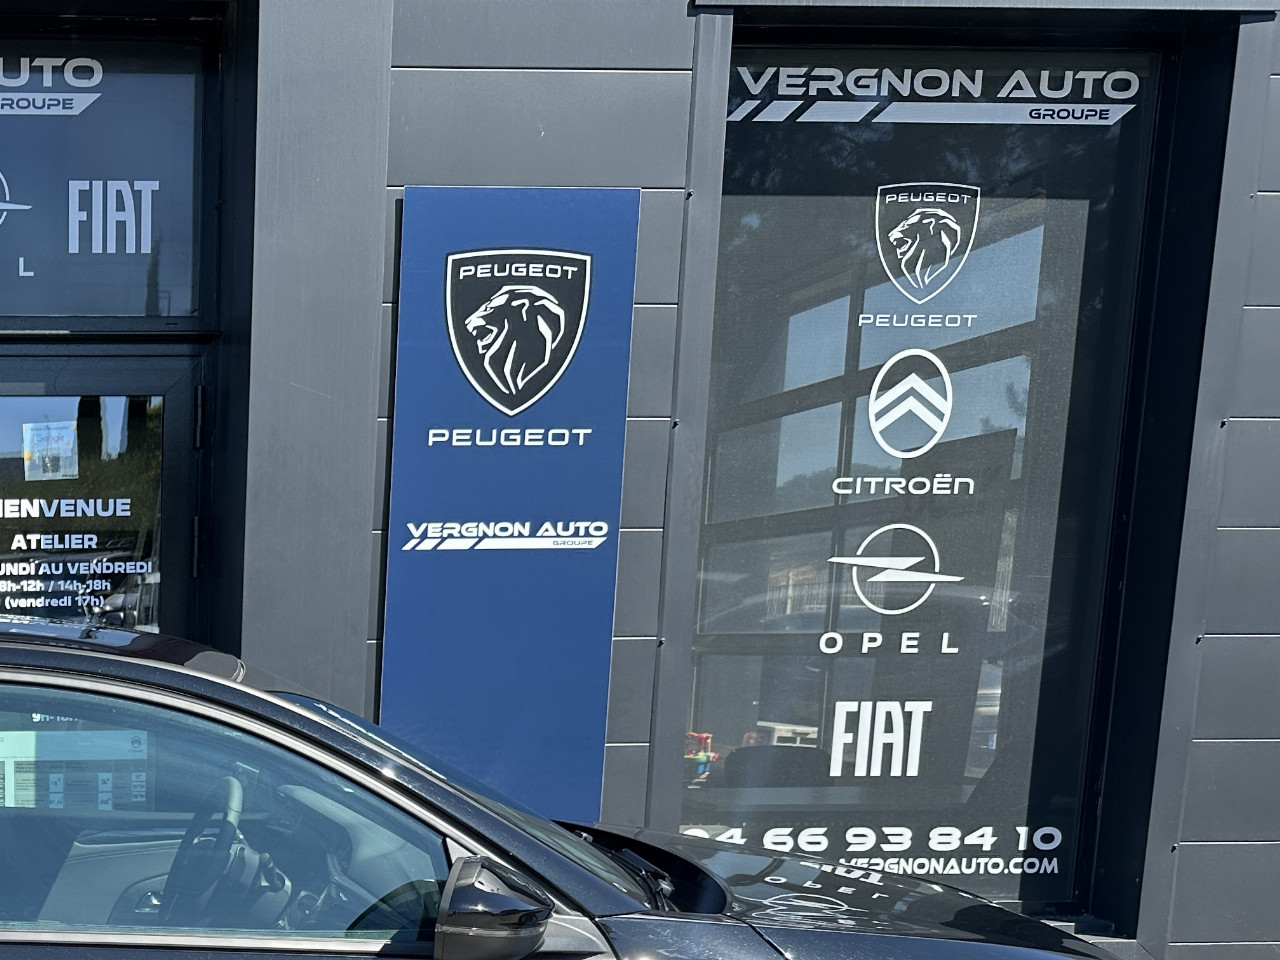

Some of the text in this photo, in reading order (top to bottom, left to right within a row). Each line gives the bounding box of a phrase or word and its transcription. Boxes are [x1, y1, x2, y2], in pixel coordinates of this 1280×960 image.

[736, 66, 1140, 99] VERGNON AUTO
[1028, 108, 1111, 120] GROUPE
[885, 192, 972, 205] PEUGEOT
[68, 180, 160, 254] FIAT
[458, 263, 578, 280] PEUGEOT
[858, 314, 978, 328] PEUGEOT
[427, 427, 593, 447] PEUGEOT
[406, 521, 609, 538] VERGNON AUTO
[10, 533, 98, 550] ATELIER
[552, 539, 594, 547] GROUPE
[38, 561, 64, 576] AU
[67, 561, 153, 575] VENDREDI
[48, 581, 54, 592] /
[57, 579, 111, 592] 14h-18h
[4, 595, 105, 610] (vendredi 17h)
[819, 632, 960, 654] OPEL
[829, 700, 933, 777] FIAT
[763, 826, 830, 853] 66
[844, 826, 913, 852] 93
[927, 826, 999, 852] 84
[1016, 826, 1063, 851] 10
